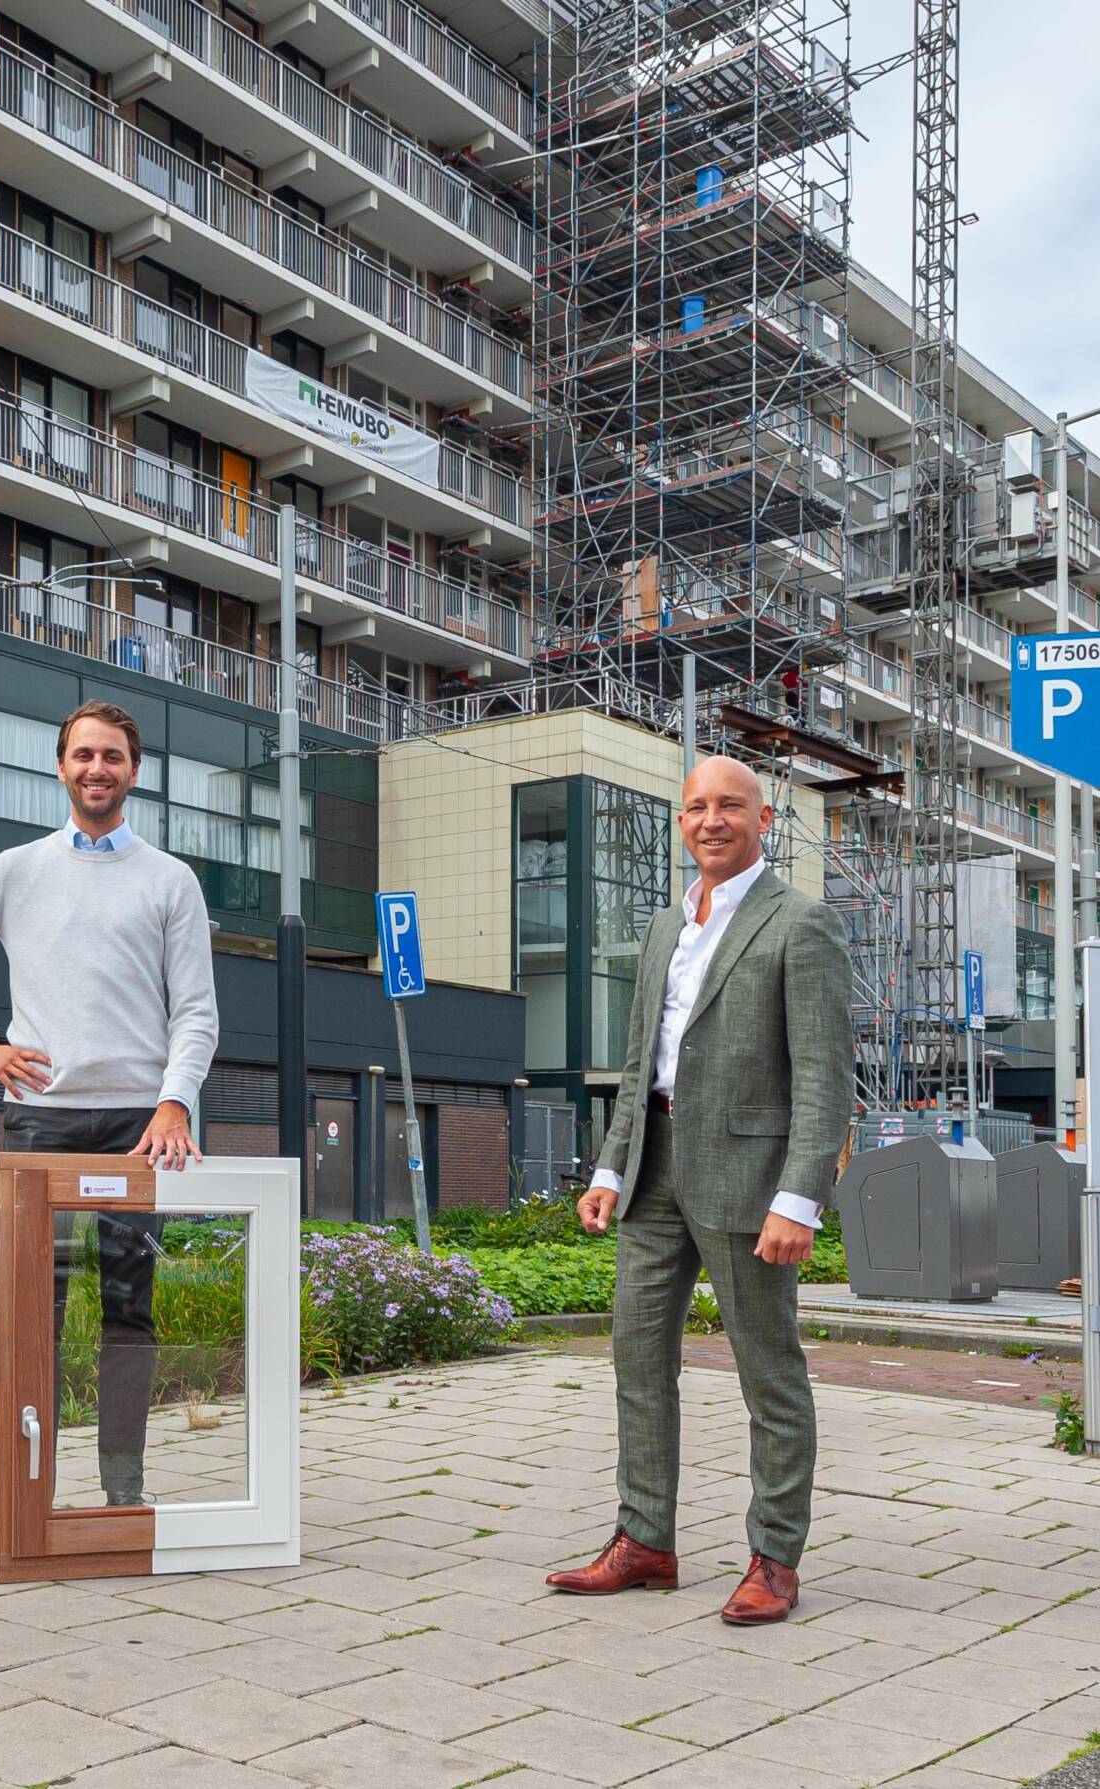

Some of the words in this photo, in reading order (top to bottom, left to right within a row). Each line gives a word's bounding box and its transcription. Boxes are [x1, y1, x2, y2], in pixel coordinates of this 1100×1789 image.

[317, 389, 389, 440] HEMUBO
[1040, 643, 1100, 663] 17506
[1042, 679, 1083, 740] P
[388, 903, 411, 954] P
[970, 956, 980, 988] P
